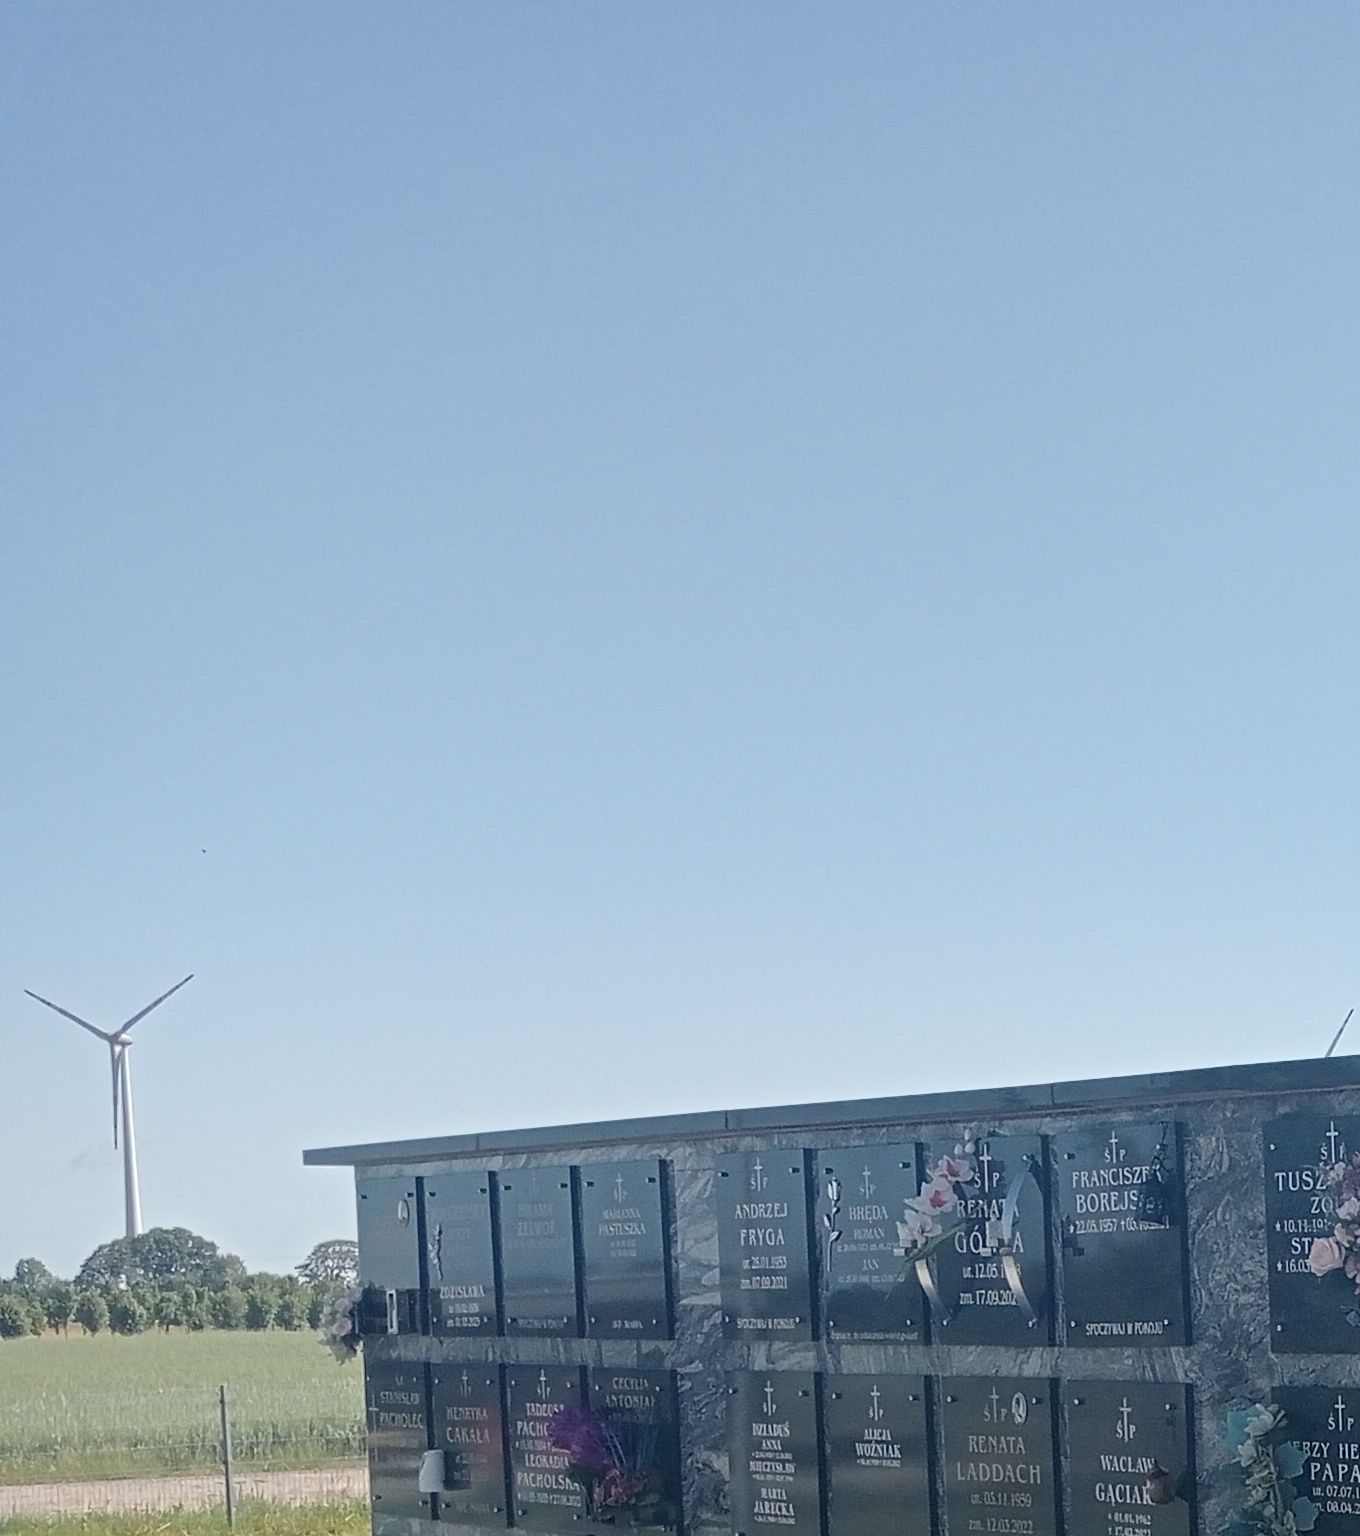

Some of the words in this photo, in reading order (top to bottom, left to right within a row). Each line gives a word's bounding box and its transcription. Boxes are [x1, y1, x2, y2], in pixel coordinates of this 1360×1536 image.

[734, 1203, 788, 1219] ANDRZEJ
[740, 1228, 786, 1246] FRYGA
[1347, 1418, 1354, 1431] P
[969, 1435, 1026, 1455] RENATA
[957, 1462, 1041, 1485] LADDACH
